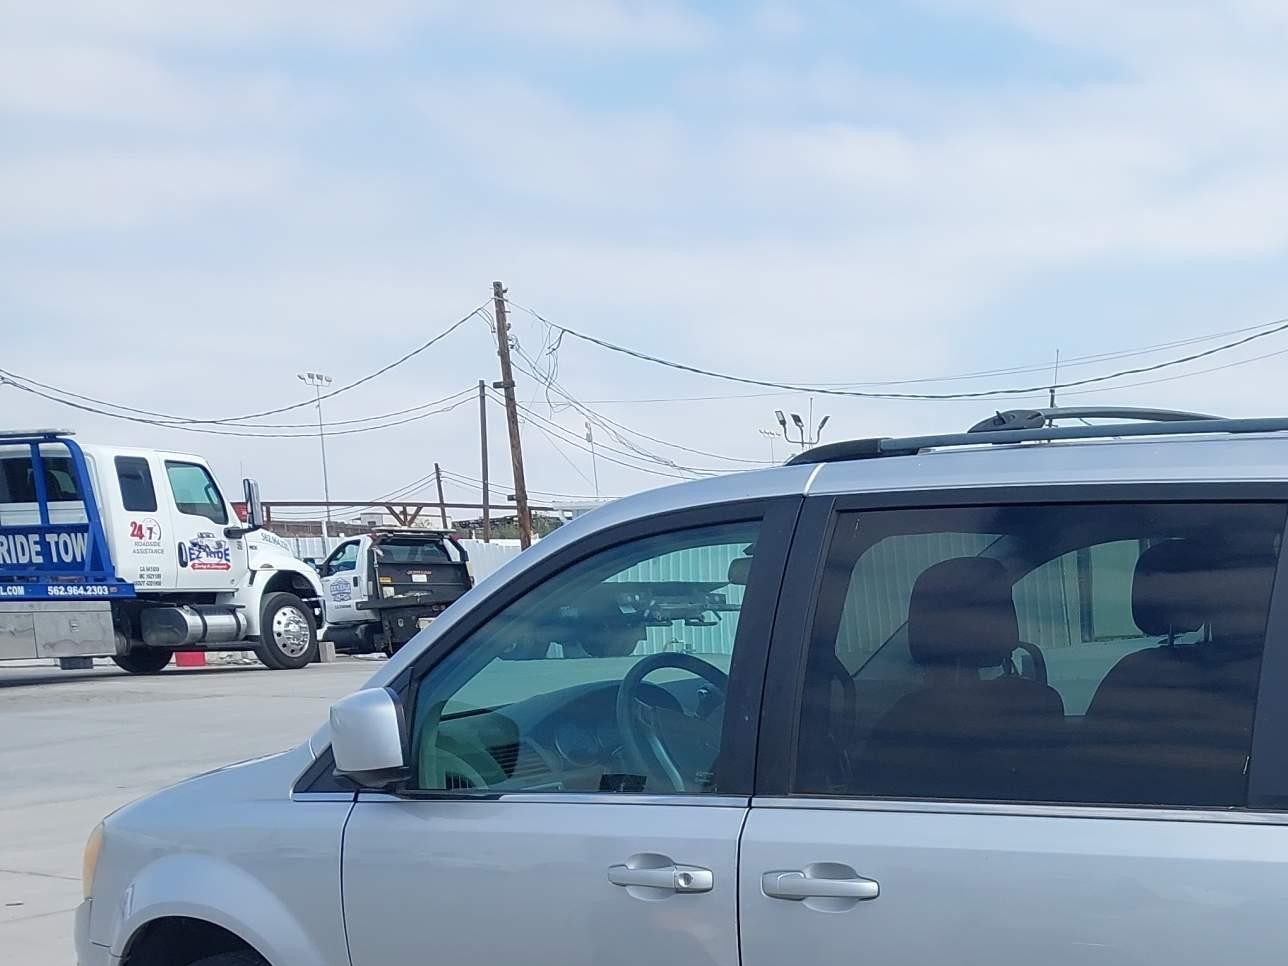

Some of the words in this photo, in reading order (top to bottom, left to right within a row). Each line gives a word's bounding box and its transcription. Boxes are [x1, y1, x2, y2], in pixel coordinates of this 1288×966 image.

[130, 521, 144, 540] 24
[0, 534, 44, 564] RIDE
[45, 533, 88, 563] TOW
[47, 585, 109, 596] 562.964.2303
